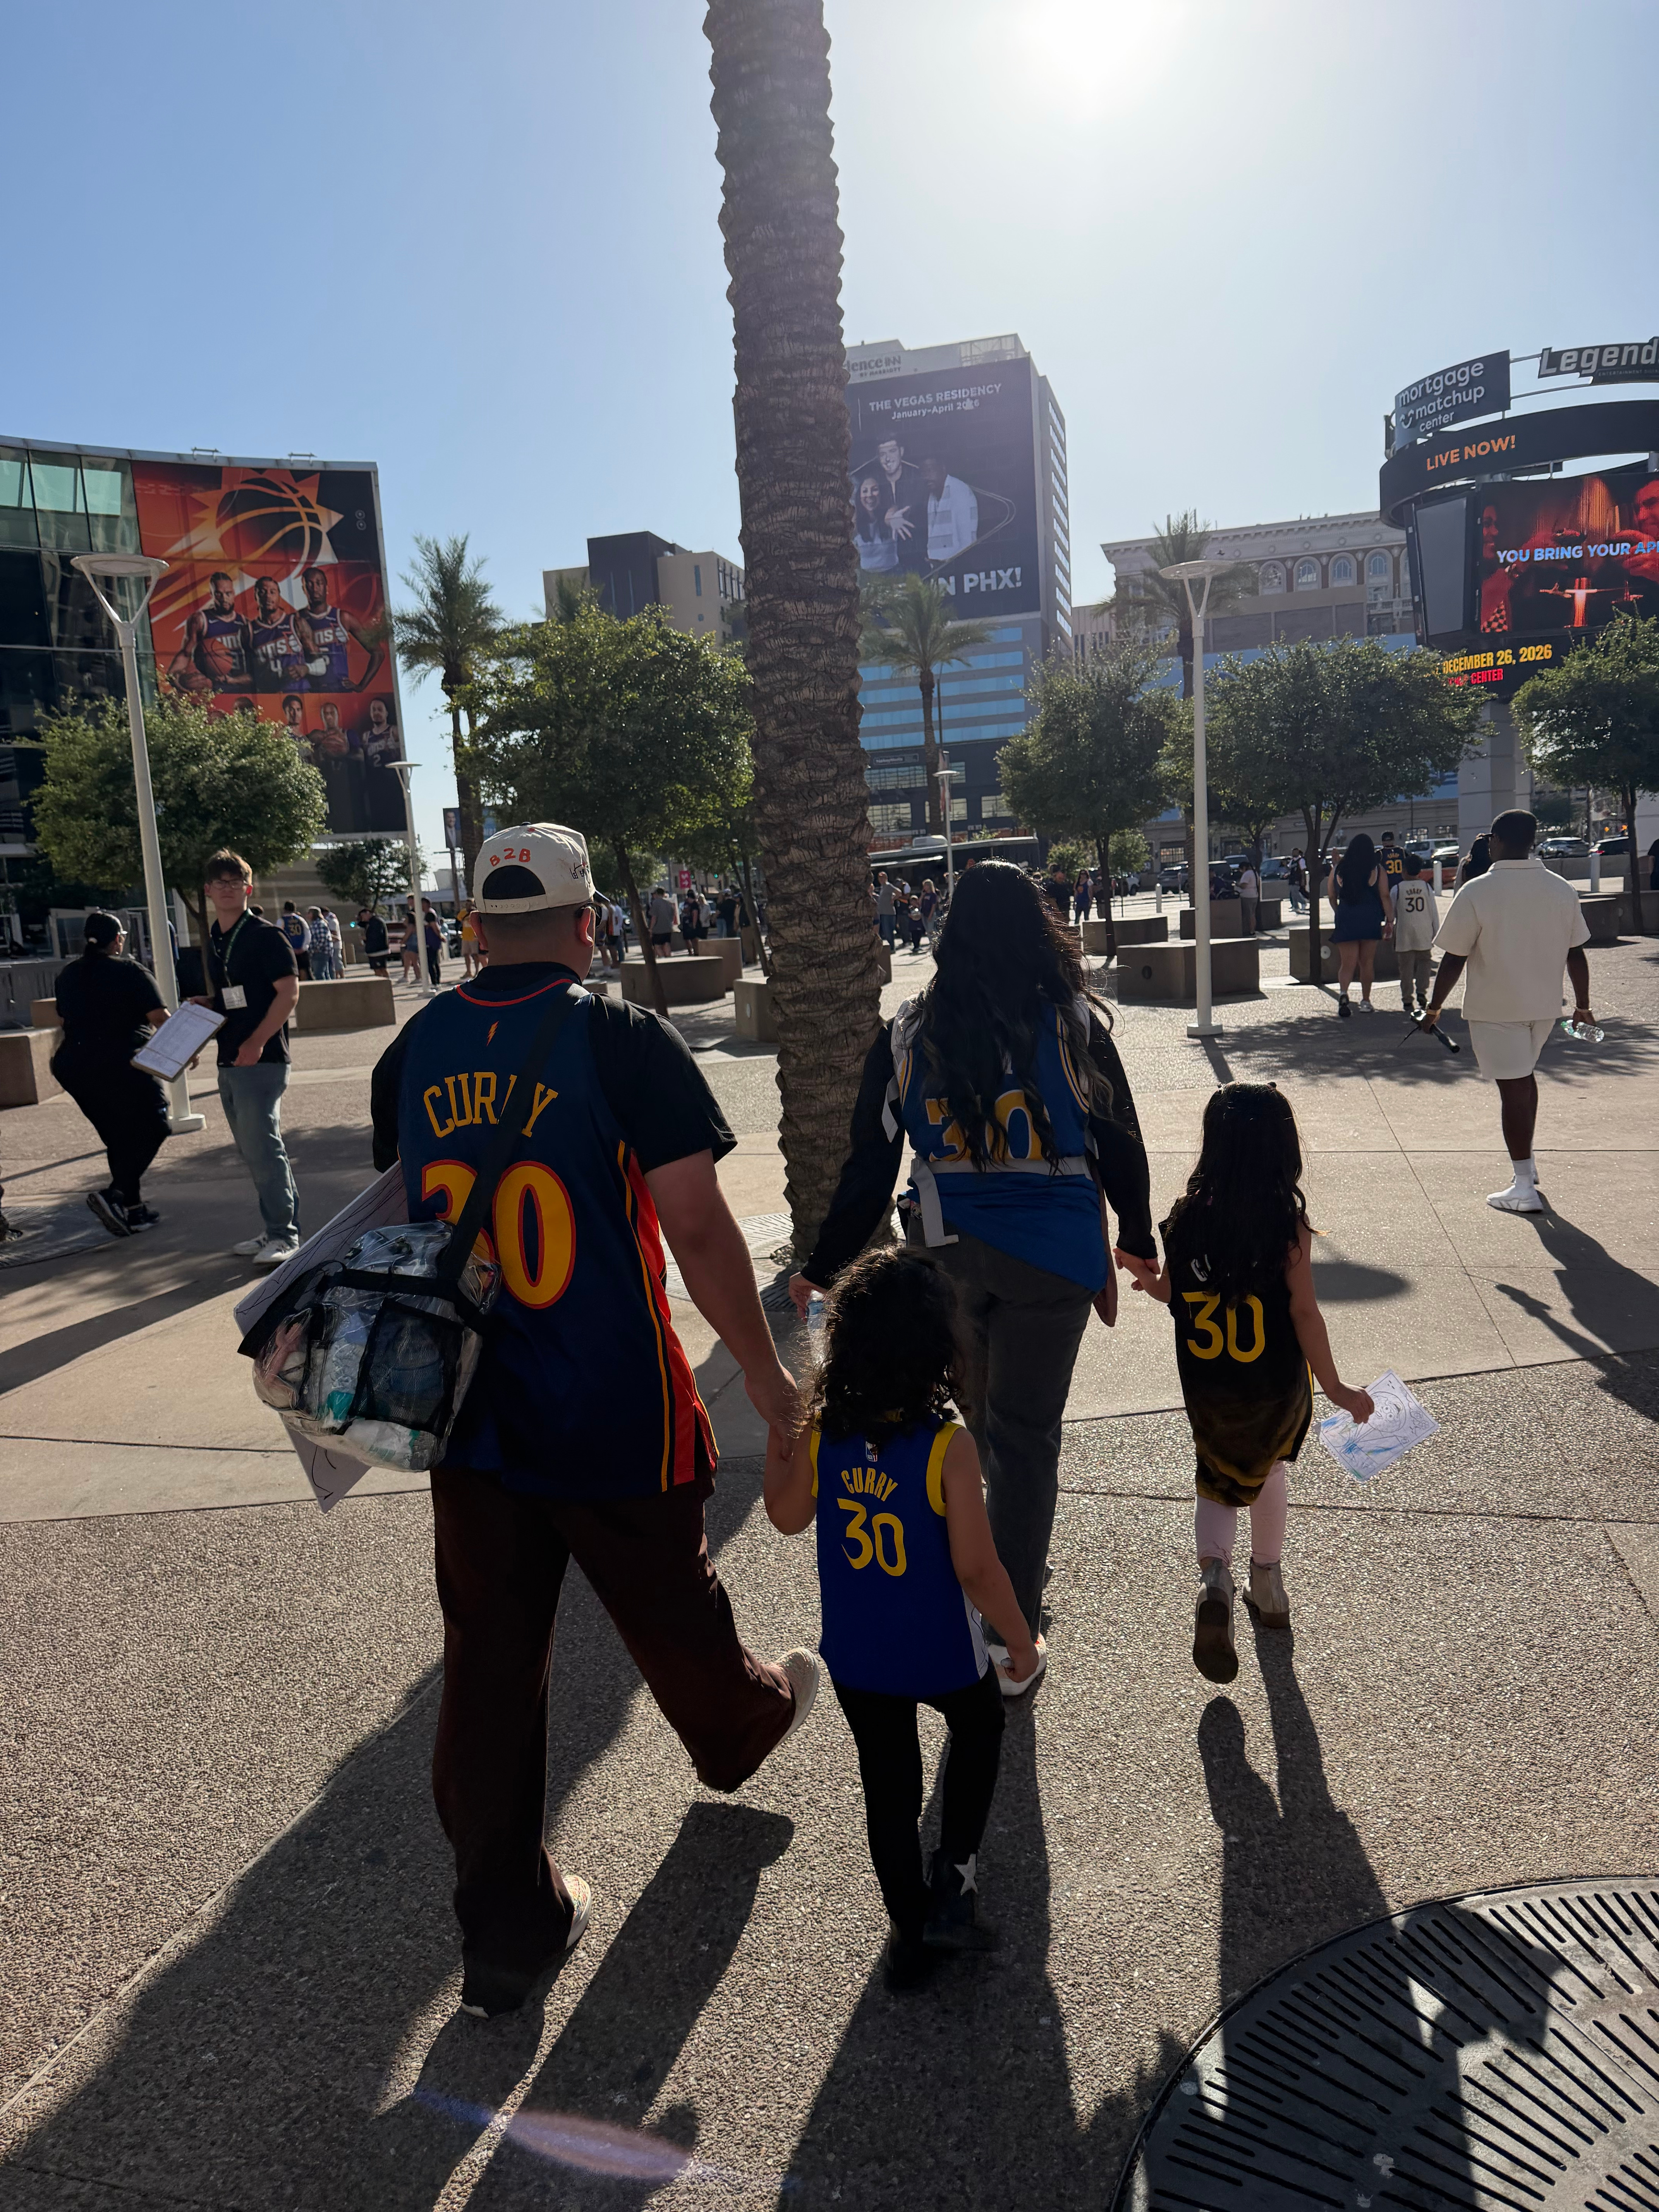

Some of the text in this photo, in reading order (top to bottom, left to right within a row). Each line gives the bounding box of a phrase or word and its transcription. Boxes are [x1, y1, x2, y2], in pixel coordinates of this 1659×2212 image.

[1540, 338, 1659, 375] Legend
[869, 383, 1001, 412] THE VEGAS RESIDENCY
[1399, 362, 1484, 407] mortgage
[891, 399, 980, 420] January-April 206
[1416, 386, 1485, 420] matchup
[1419, 412, 1455, 433] center
[1427, 434, 1516, 471] LIVE NOW!
[1496, 541, 1659, 563] YOU BRING YOUR AP
[963, 567, 1022, 594] PHX!
[270, 658, 282, 678] 4
[1442, 652, 1494, 675] DECEMBER
[1496, 649, 1516, 666] 26,
[1518, 644, 1553, 663] 2026
[1470, 668, 1504, 685] CENTER
[373, 754, 381, 768] 2
[1386, 859, 1403, 874] 30
[1405, 897, 1425, 913] 30
[288, 924, 302, 936] 30
[1182, 1291, 1265, 1363] 30
[841, 1467, 898, 1501] CURRY
[837, 1498, 907, 1577] 30
